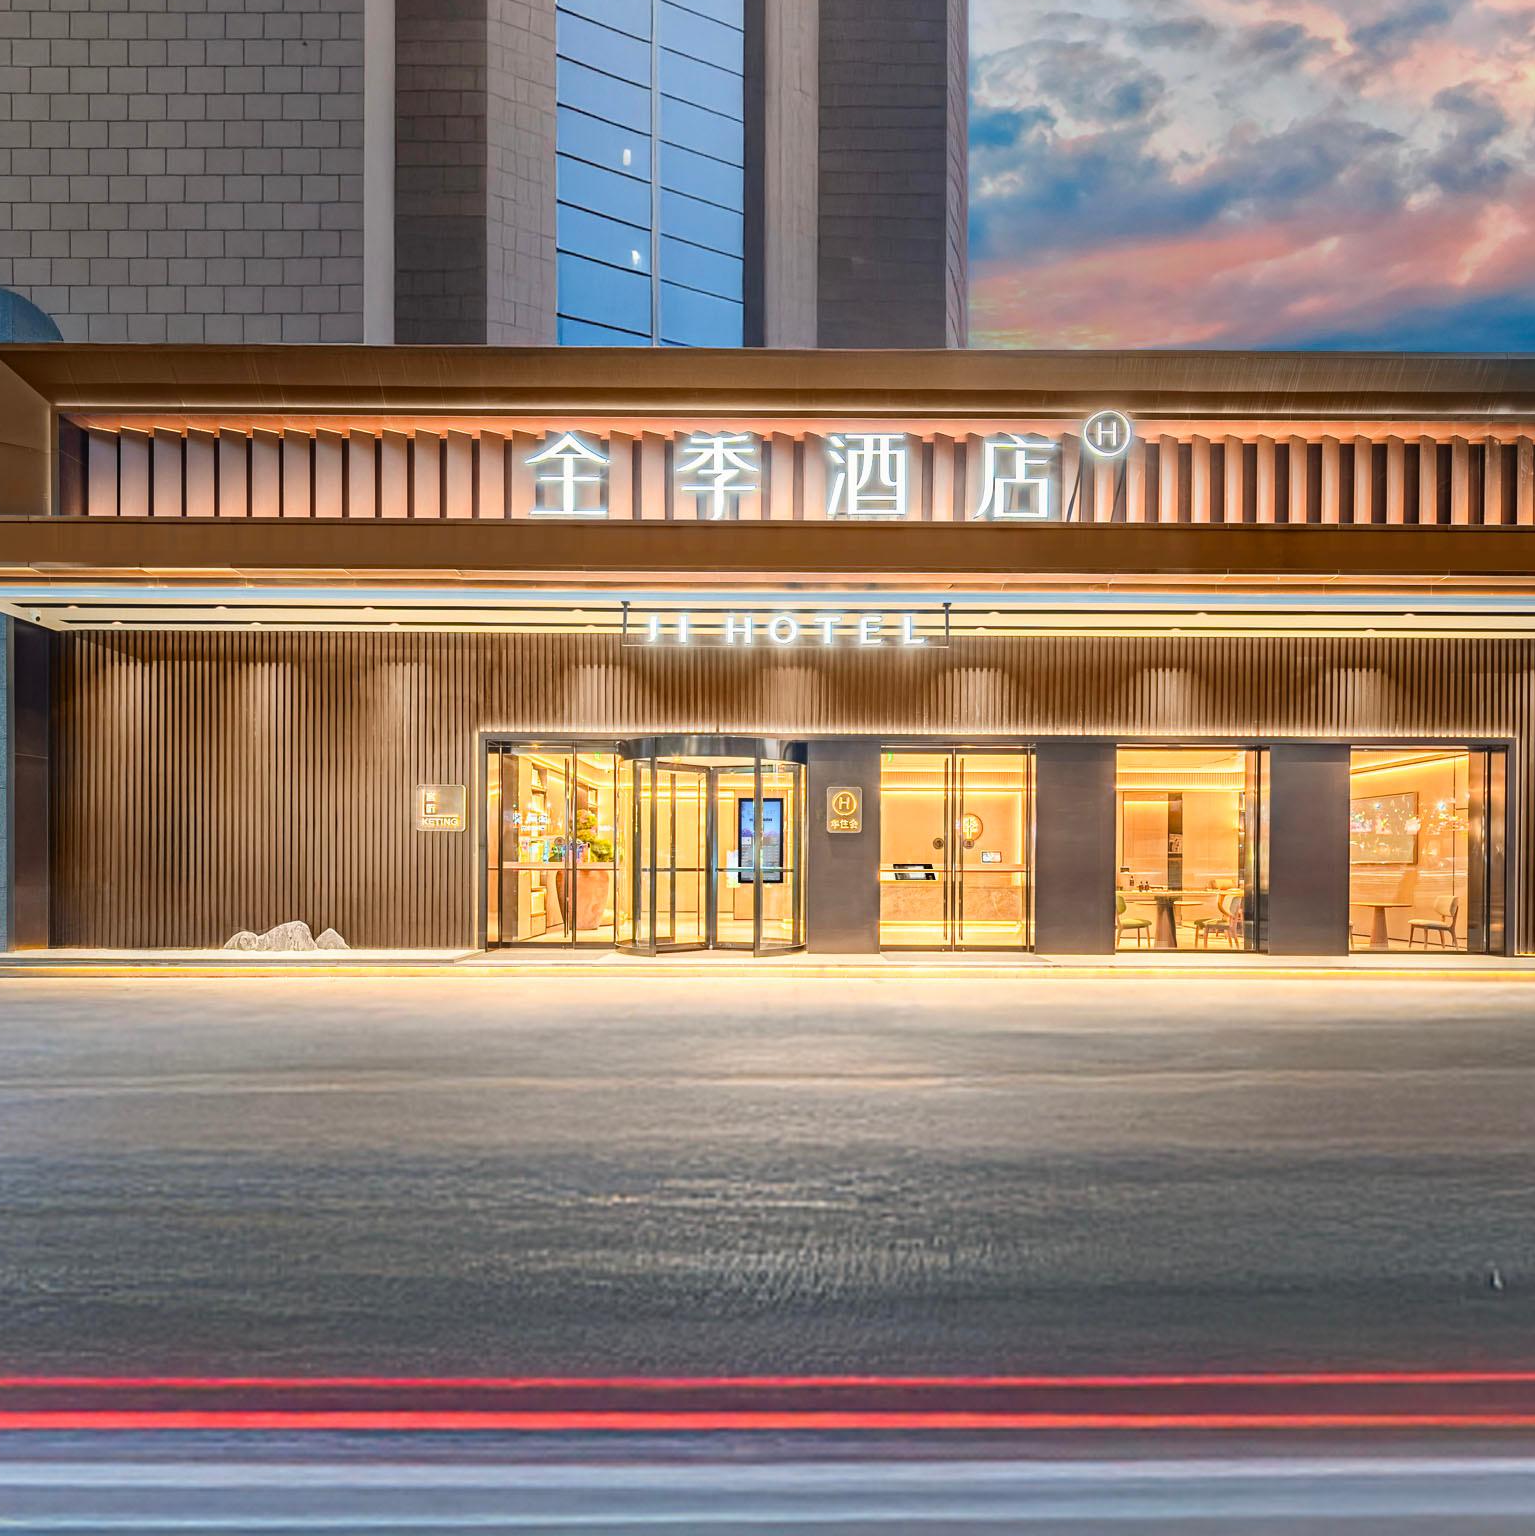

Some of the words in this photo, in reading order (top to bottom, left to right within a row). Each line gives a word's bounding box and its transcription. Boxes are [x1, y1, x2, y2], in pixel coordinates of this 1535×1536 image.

[524, 432, 1056, 521] 全季酒店
[647, 615, 689, 643] JI
[726, 615, 926, 645] HOTEL
[422, 817, 458, 826] KETING
